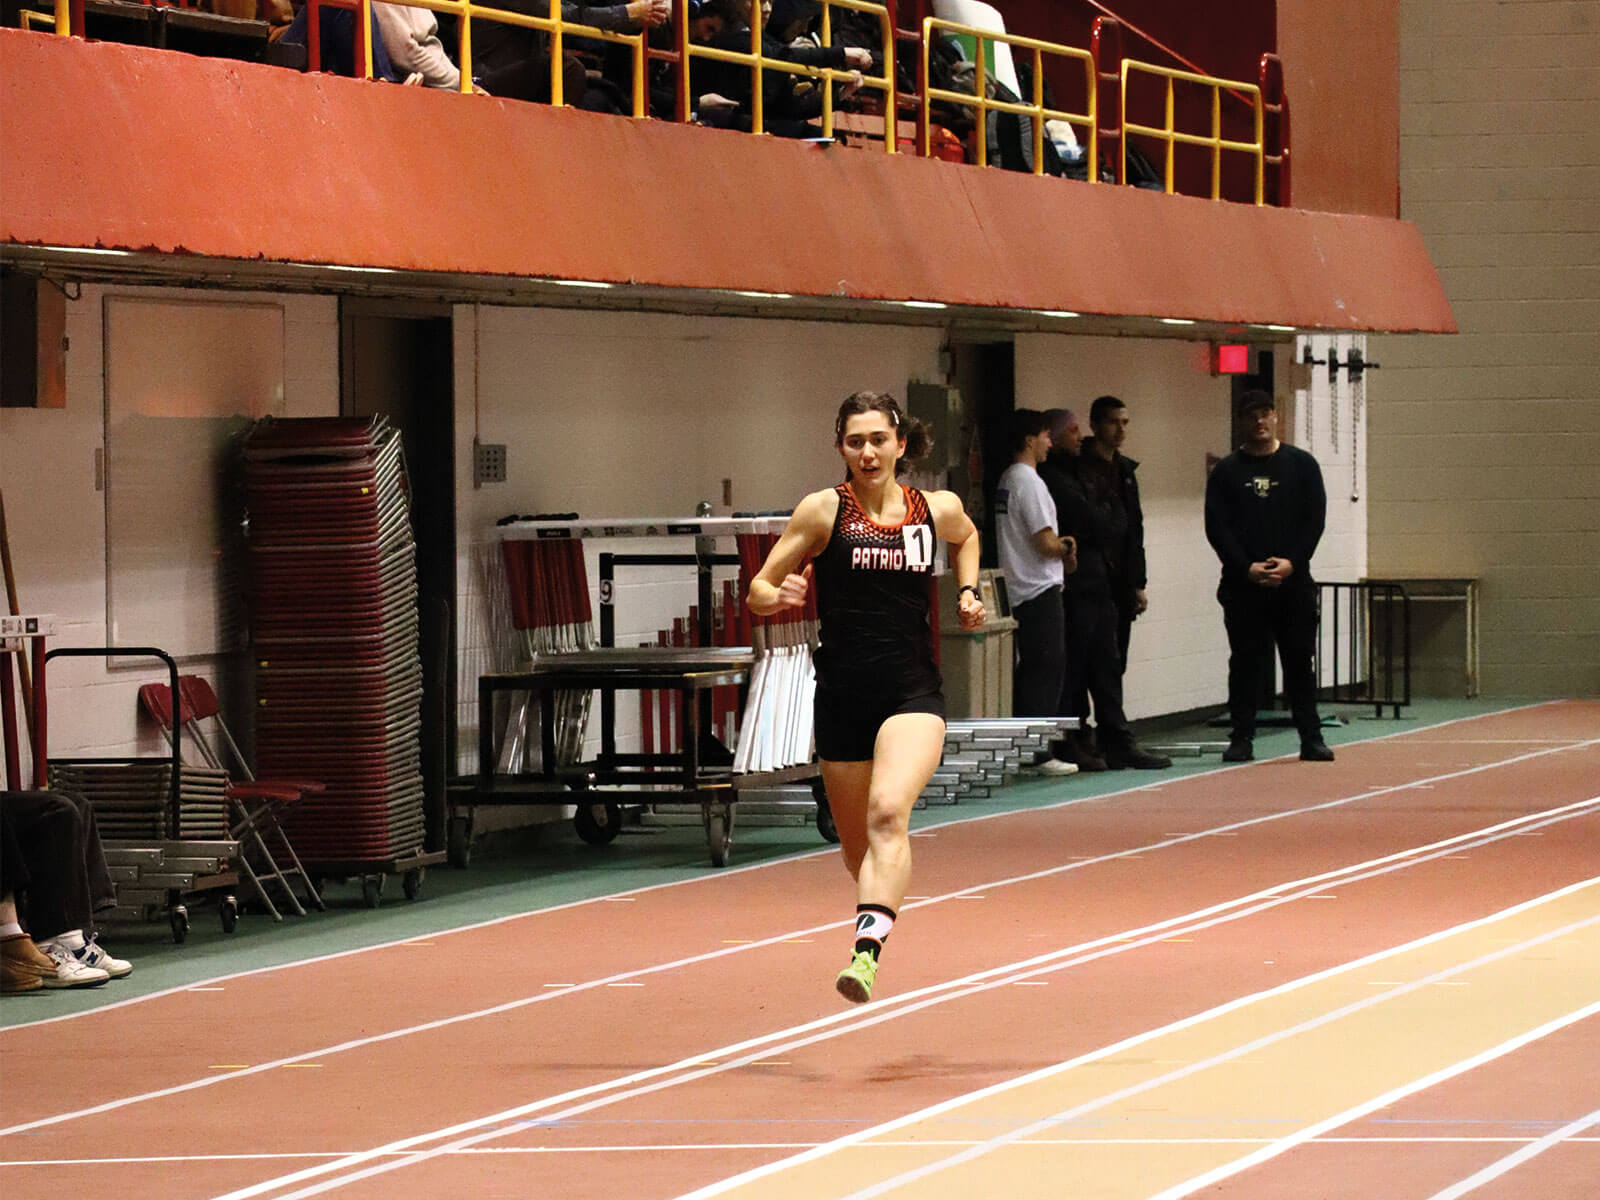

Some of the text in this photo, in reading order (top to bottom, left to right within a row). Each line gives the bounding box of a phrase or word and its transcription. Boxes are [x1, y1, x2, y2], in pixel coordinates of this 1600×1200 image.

[912, 527, 925, 562] 1
[852, 547, 927, 572] PATRIO
[601, 580, 612, 603] 9
